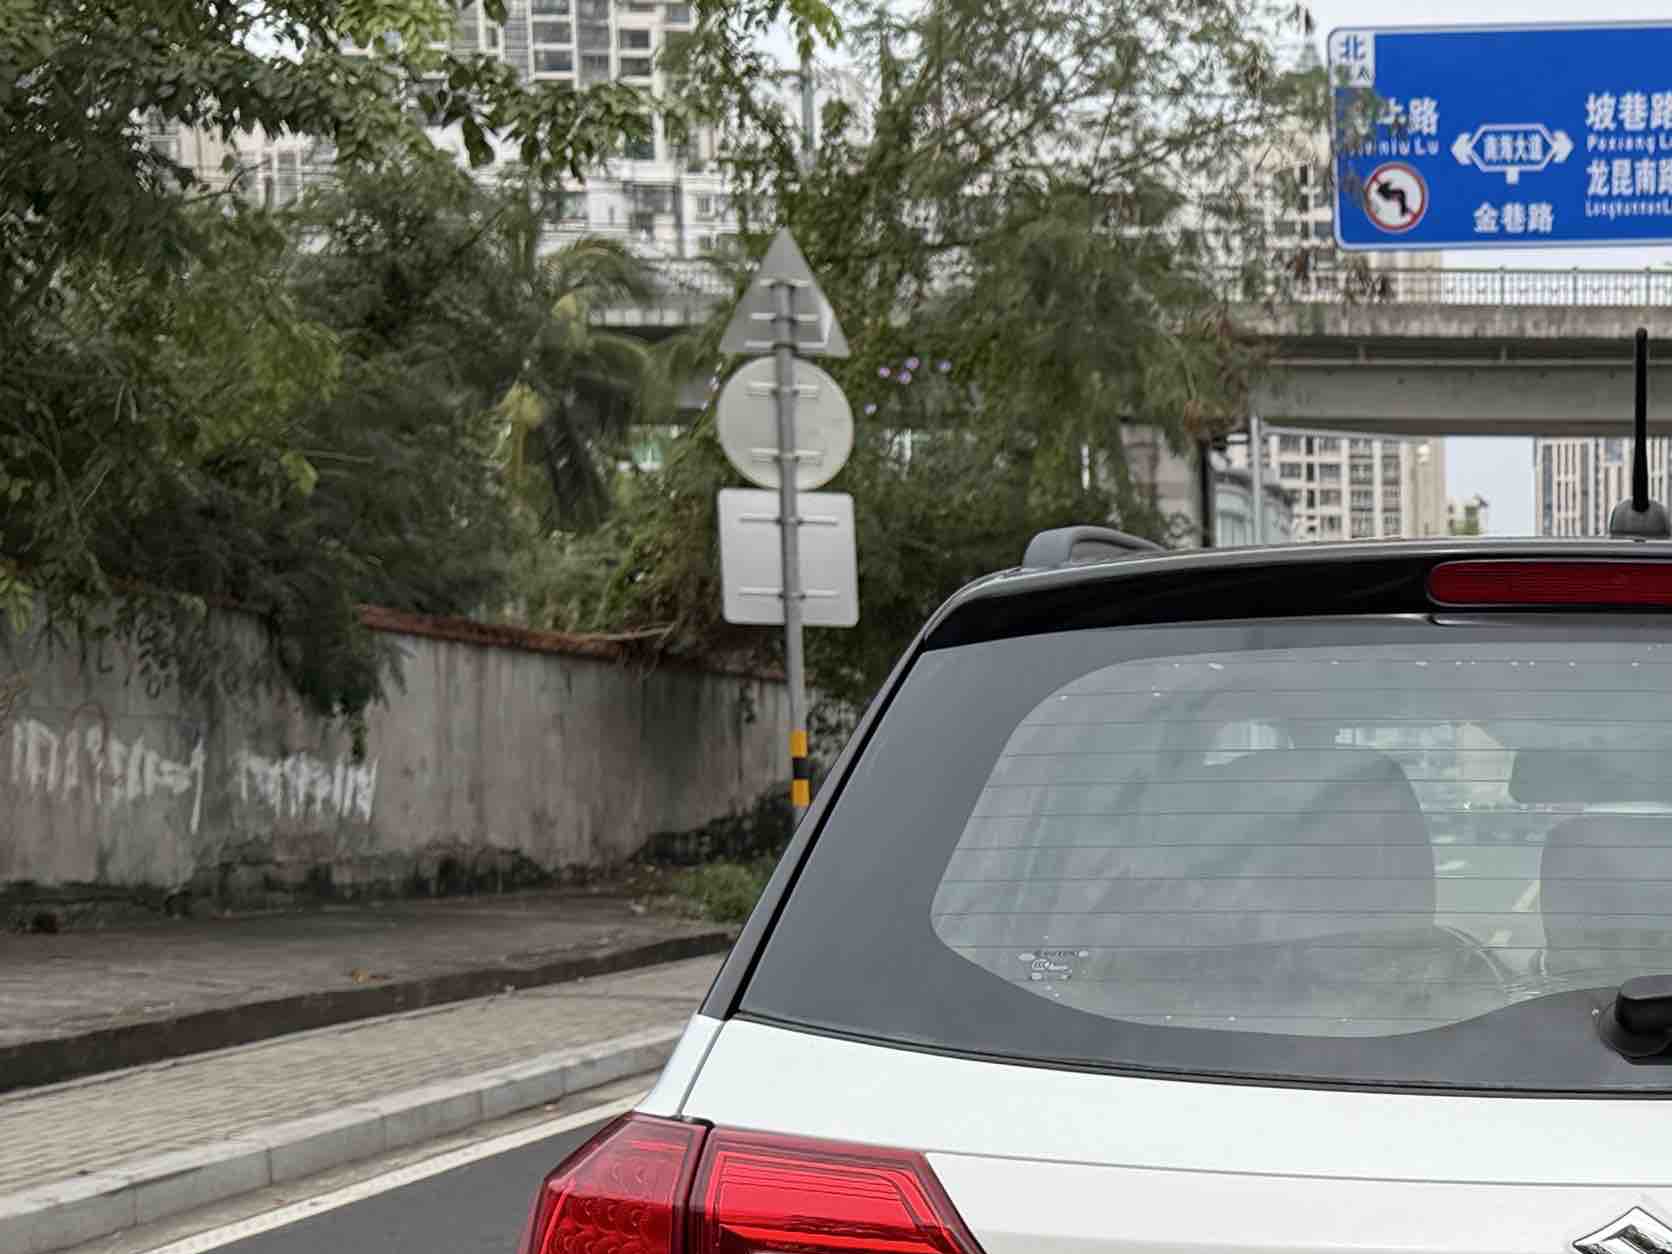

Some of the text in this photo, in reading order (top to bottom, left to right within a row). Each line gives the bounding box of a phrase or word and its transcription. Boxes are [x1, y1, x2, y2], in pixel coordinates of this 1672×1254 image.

[1339, 35, 1366, 59] 北
[1473, 202, 1554, 234] 金巷路
